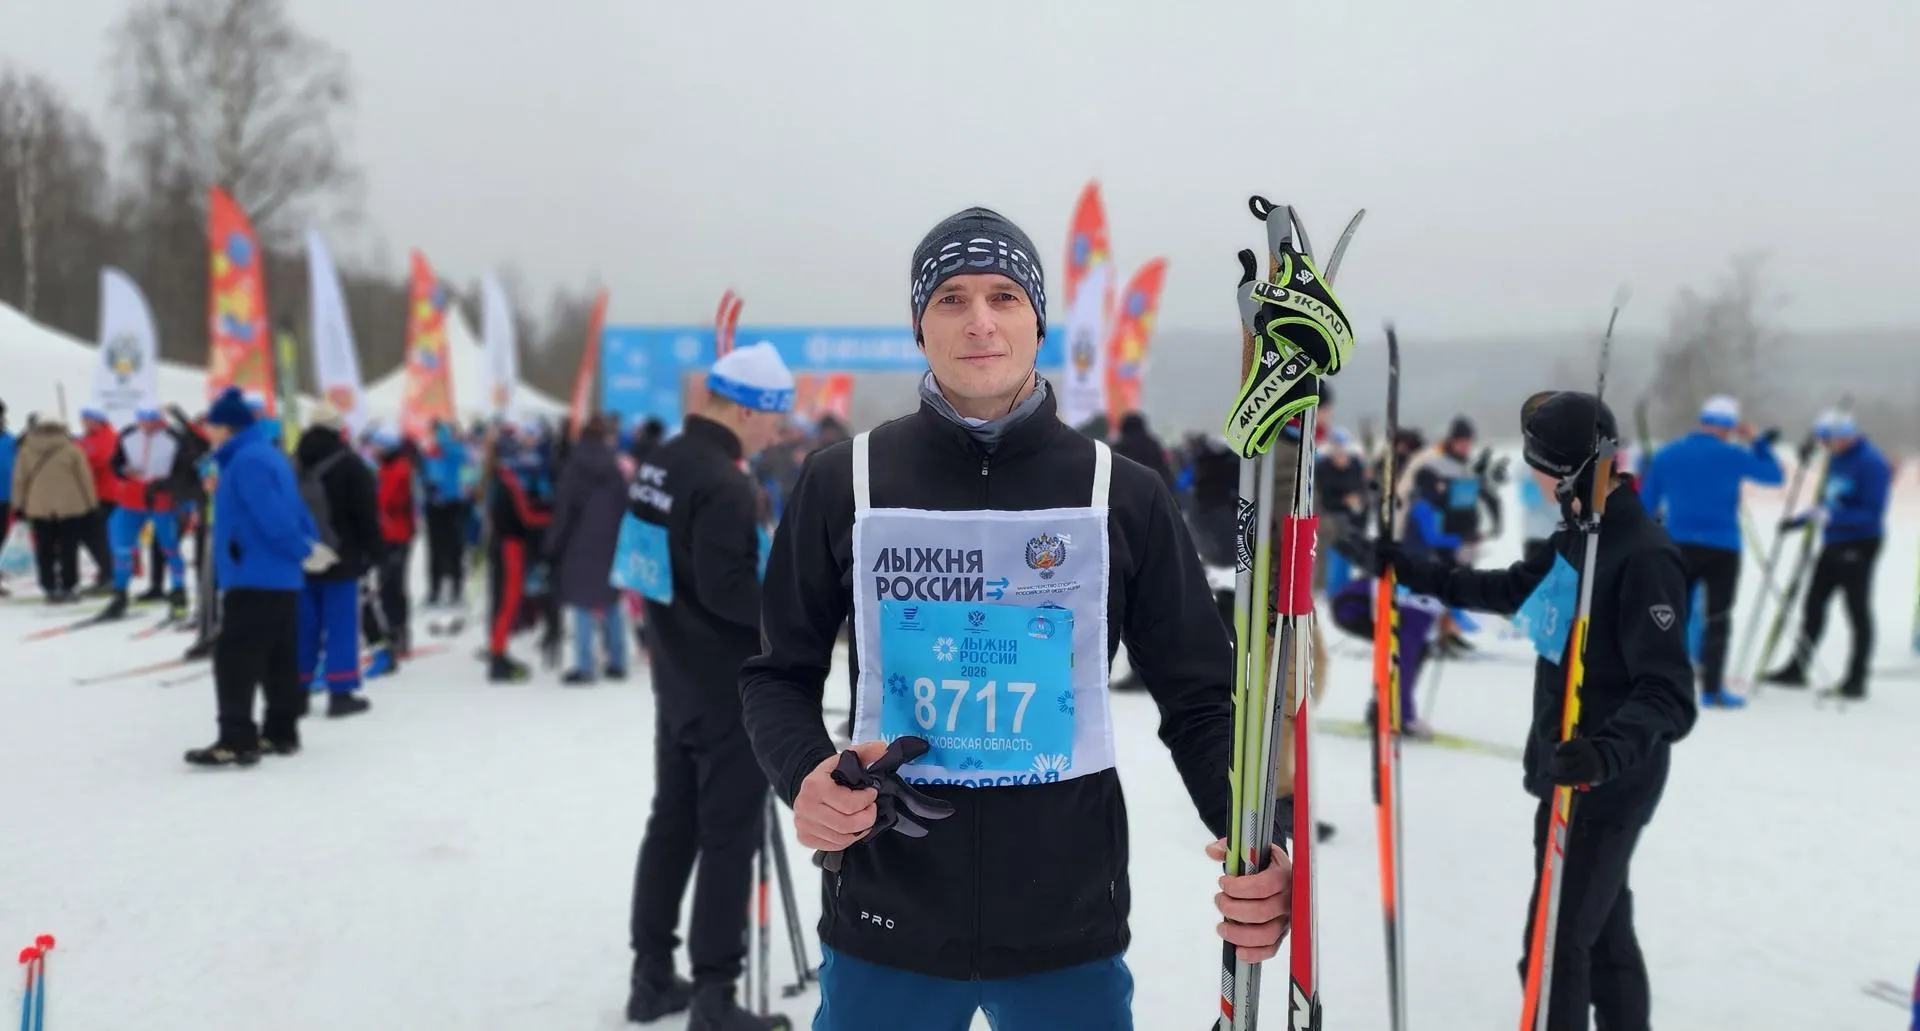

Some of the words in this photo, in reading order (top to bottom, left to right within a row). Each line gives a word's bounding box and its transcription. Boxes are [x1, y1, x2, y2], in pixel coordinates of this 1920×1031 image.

[872, 548, 983, 573] ЛЫЖНЯ
[876, 576, 984, 602] РОССИИ
[960, 637, 1017, 651] ЛЫЖНЯ
[959, 652, 1017, 664] РОССИИ
[960, 666, 987, 678] 2026
[913, 677, 1036, 733] 8717
[984, 737, 1033, 751] ОБЛАСТЬ
[861, 911, 895, 929] PRO
